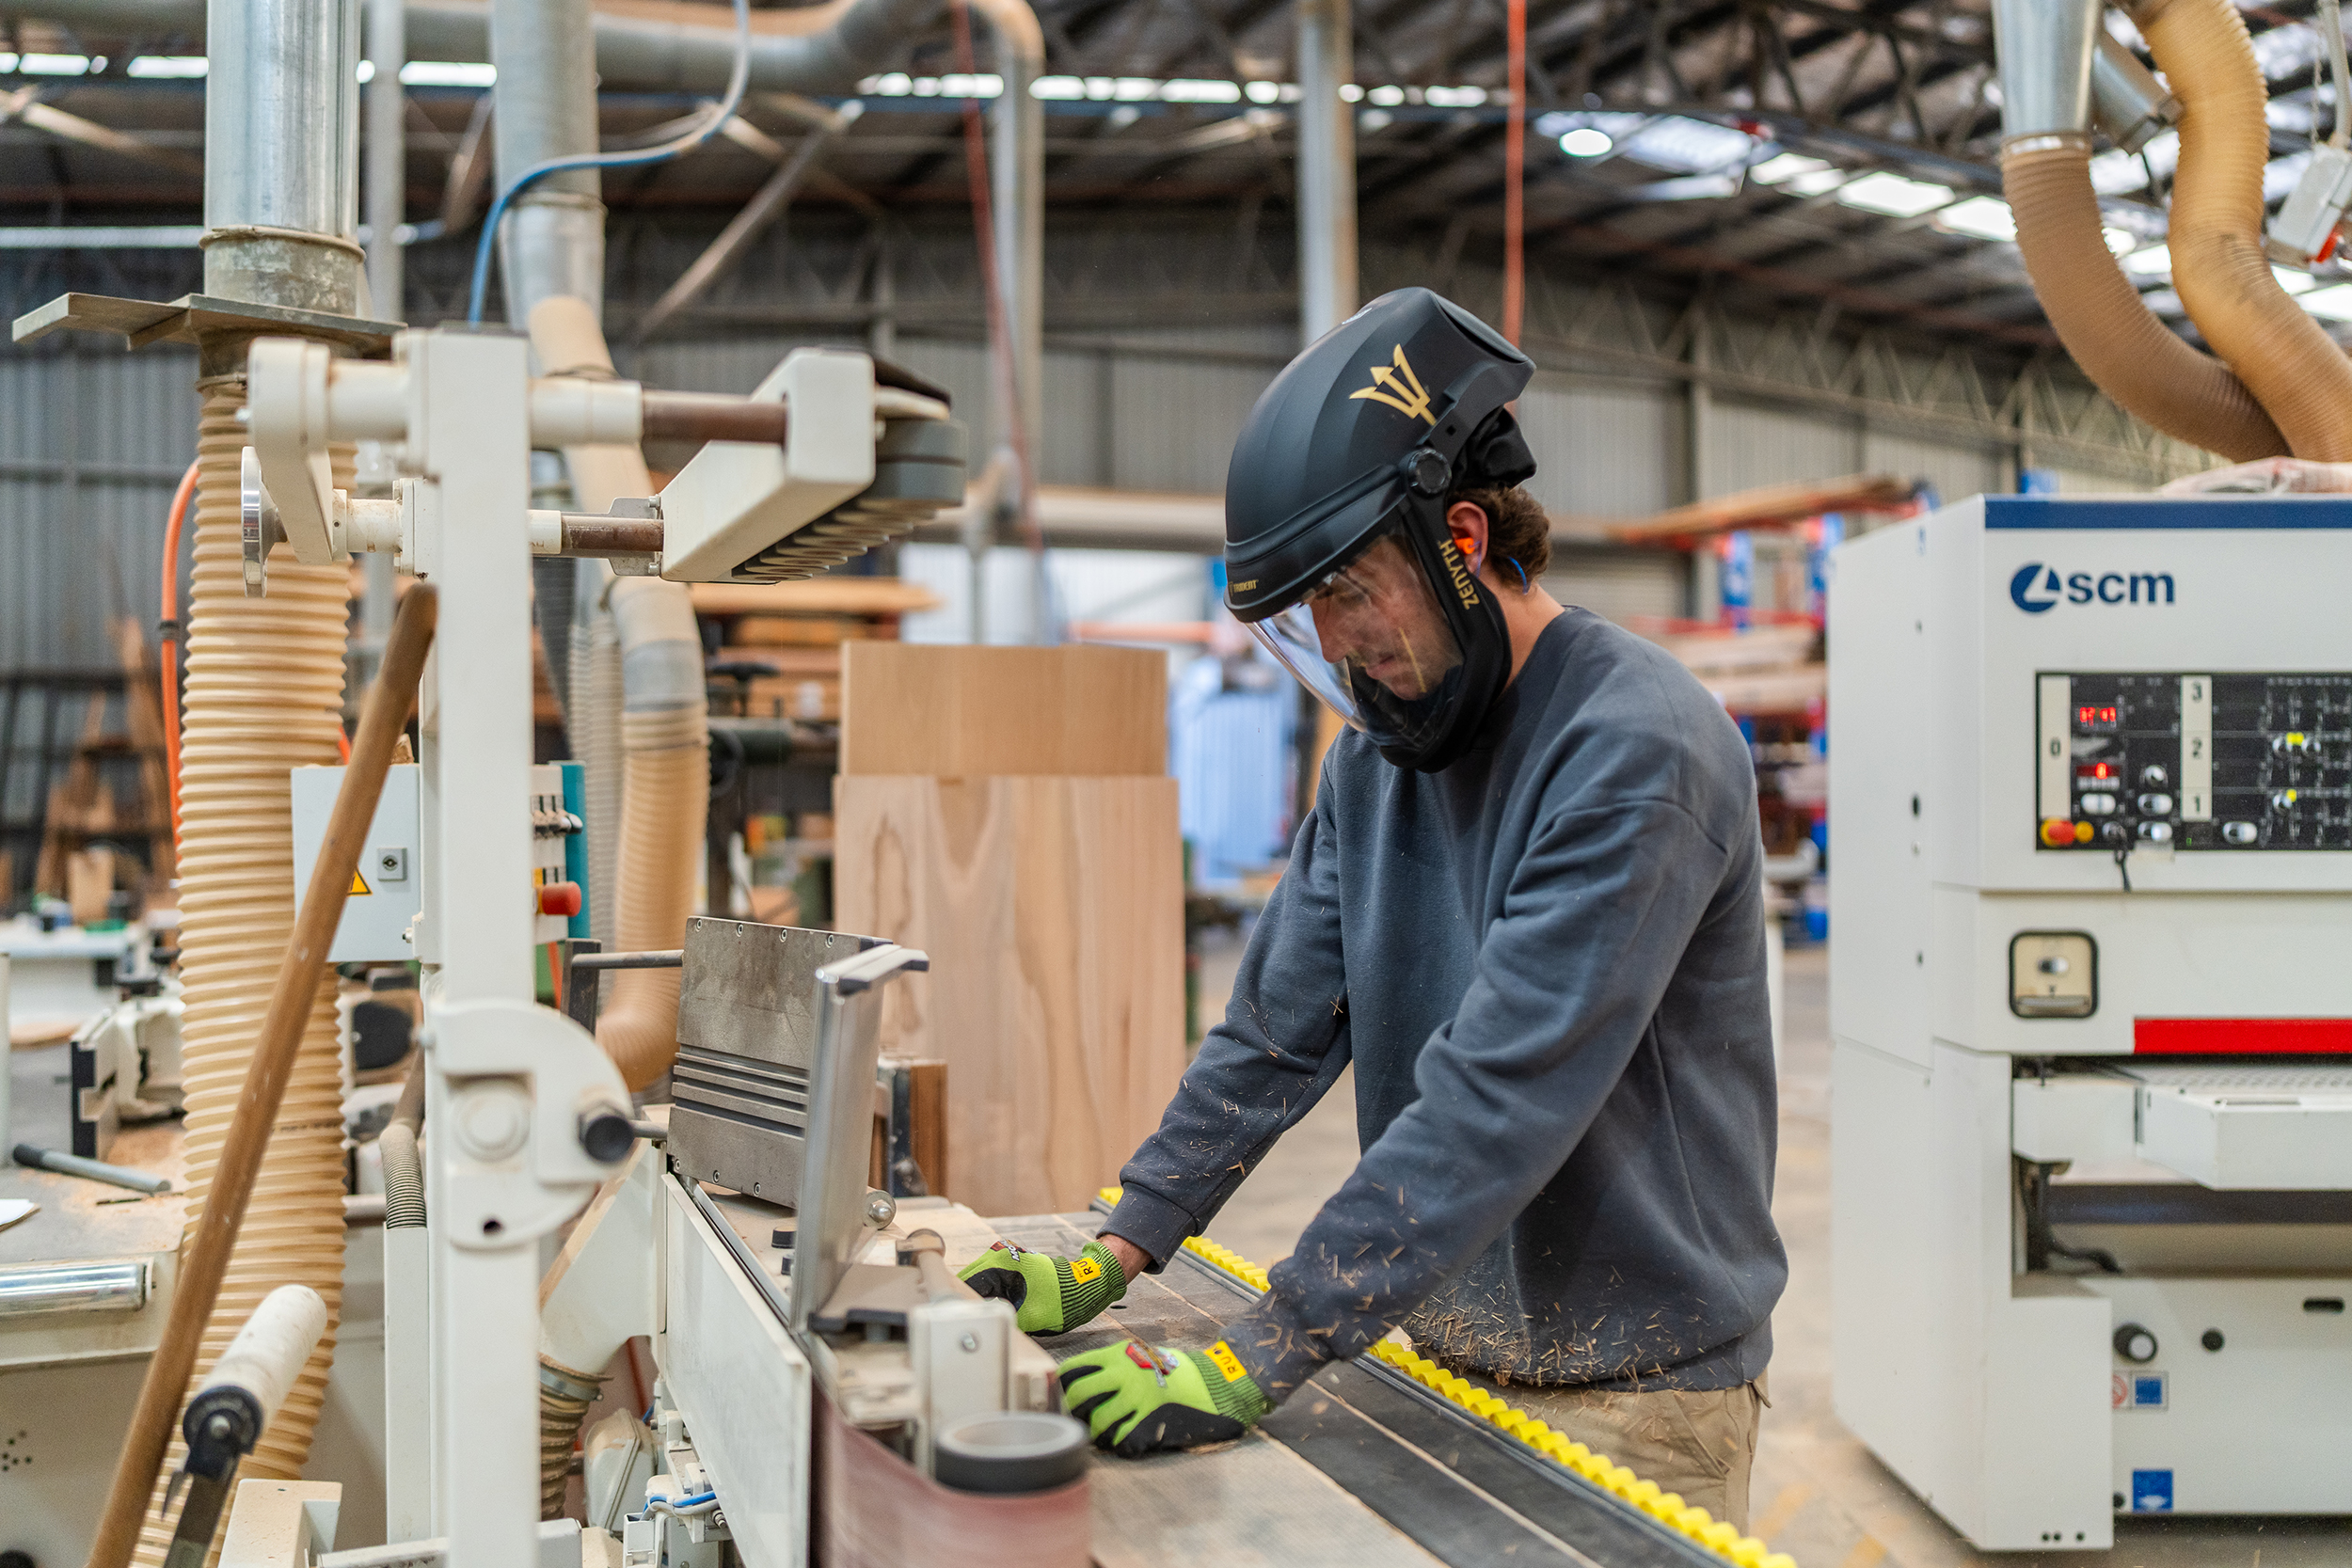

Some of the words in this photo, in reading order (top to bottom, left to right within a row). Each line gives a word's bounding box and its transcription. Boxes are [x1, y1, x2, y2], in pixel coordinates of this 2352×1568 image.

[1439, 538, 1481, 610] ZENYTH
[2067, 573, 2175, 603] scm
[2192, 681, 2203, 703] 3
[2192, 736, 2203, 760] 2
[2194, 795, 2201, 815] 1
